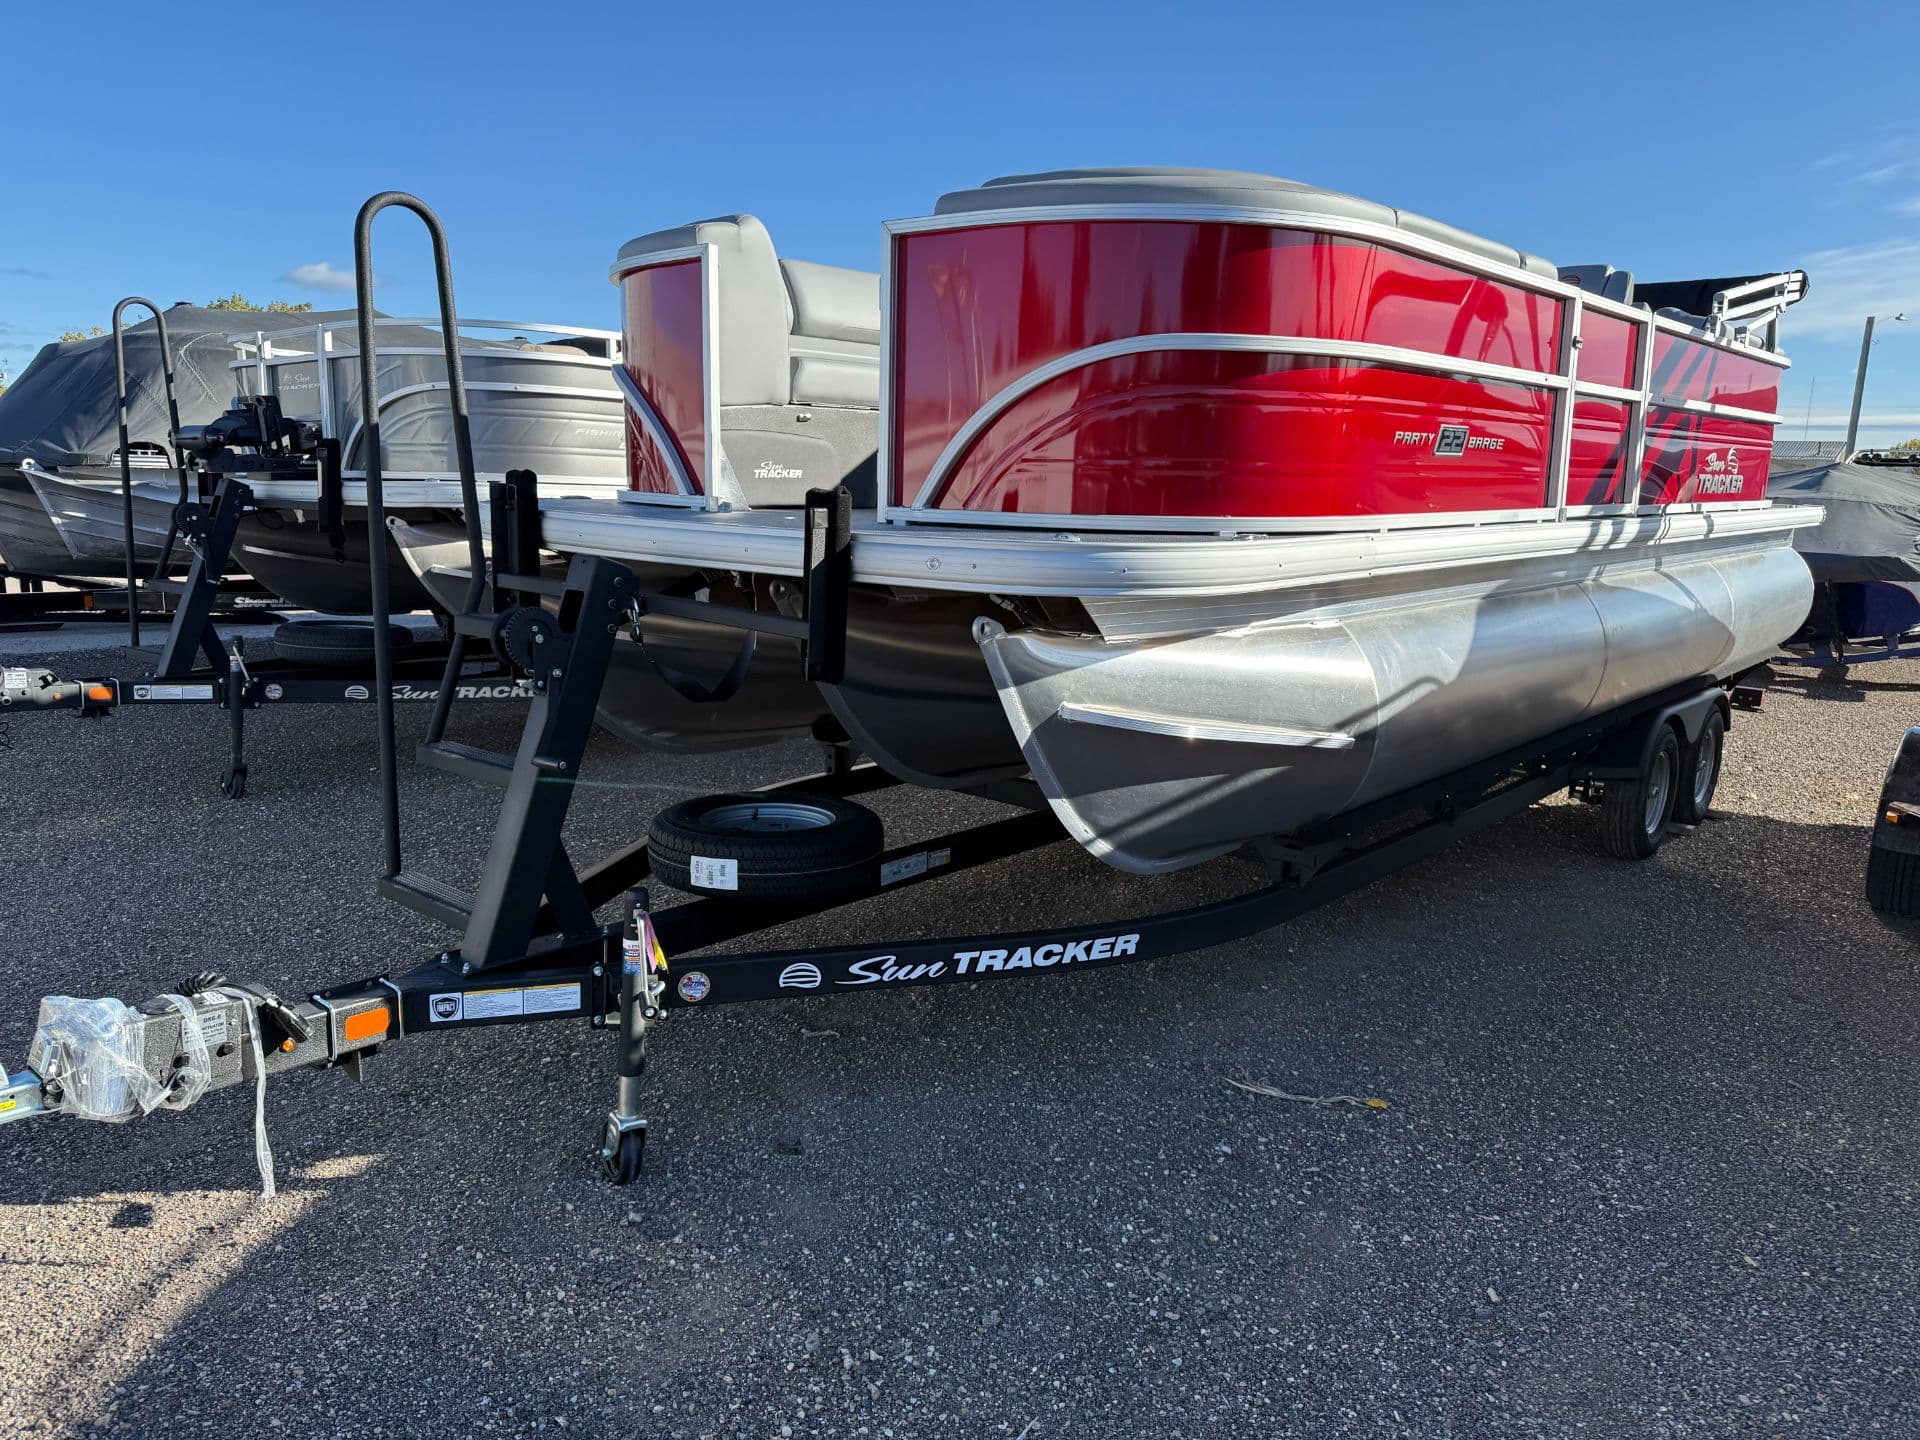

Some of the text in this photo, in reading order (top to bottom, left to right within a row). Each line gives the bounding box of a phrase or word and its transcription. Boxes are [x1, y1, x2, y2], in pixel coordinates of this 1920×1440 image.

[1393, 430, 1505, 452] PARTY 22 BARGE
[760, 461, 784, 471] Sun
[1702, 452, 1726, 472] Sun
[753, 469, 803, 479] TRACKER
[1698, 474, 1744, 494] TRACKER
[391, 685, 536, 699] Sun RACK
[834, 933, 1141, 985] Sun TRACKER
